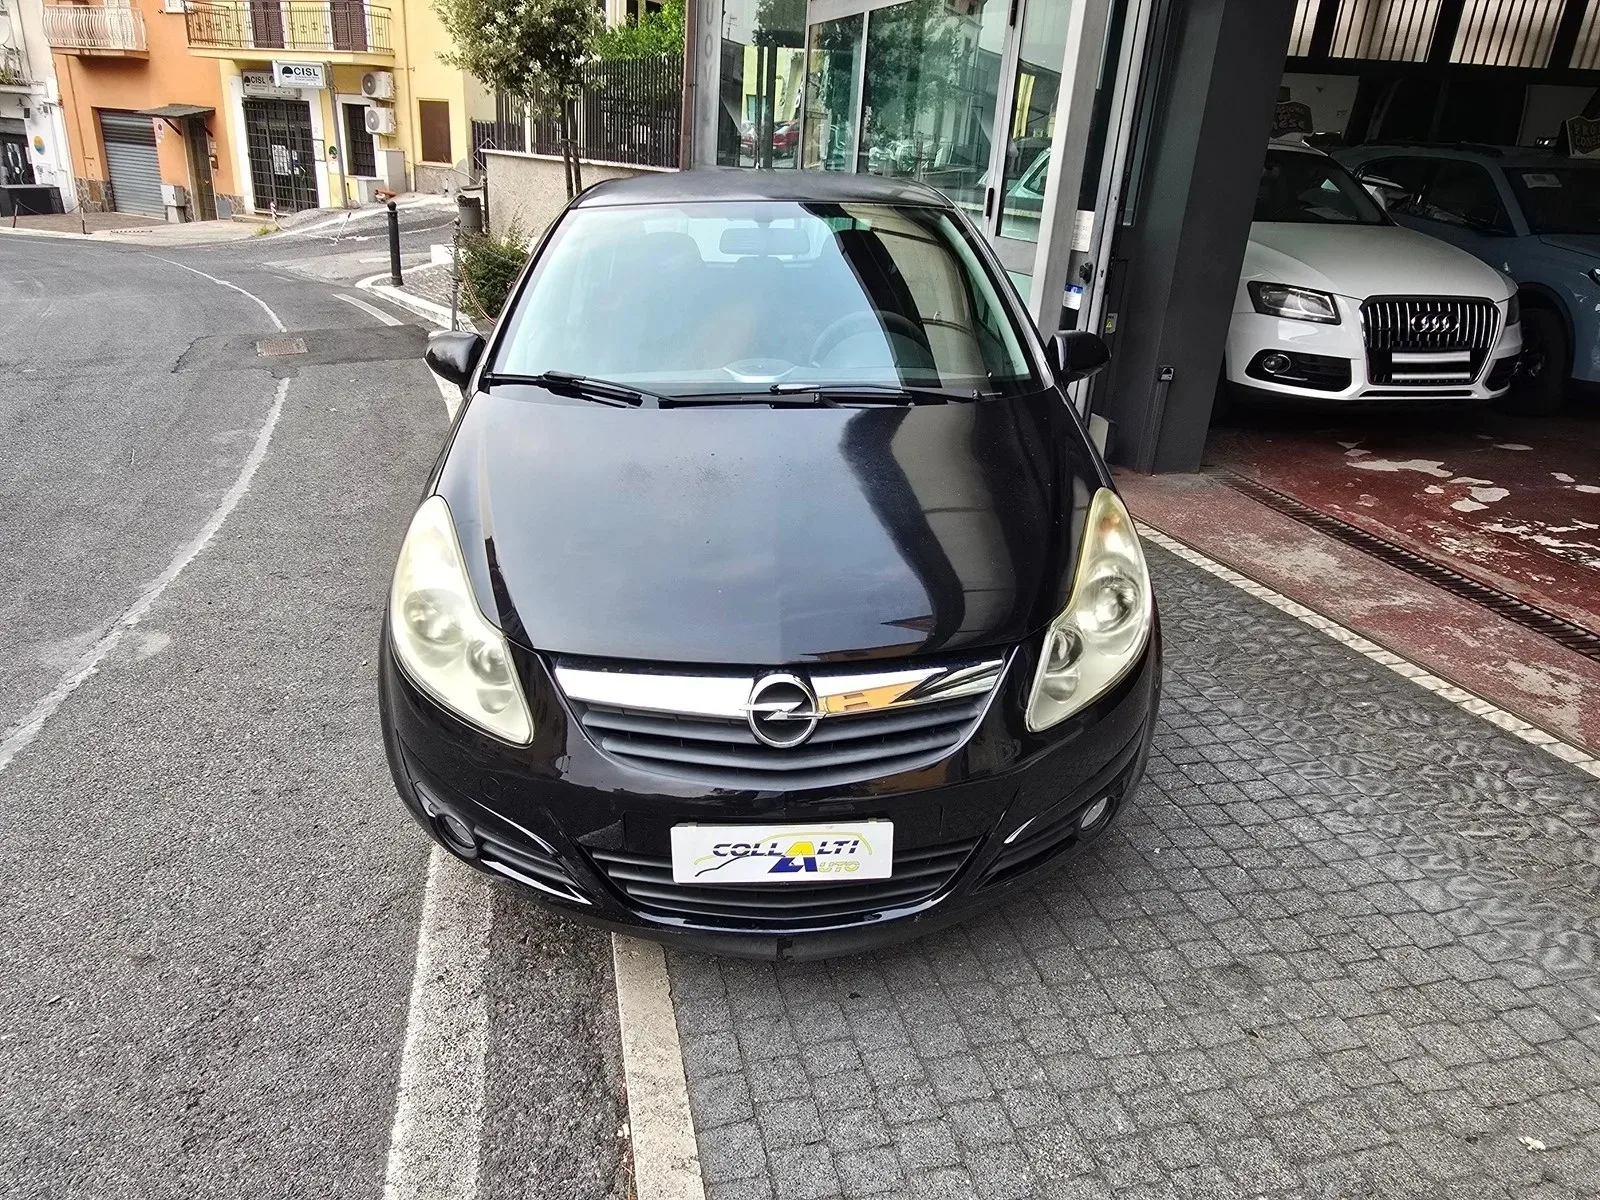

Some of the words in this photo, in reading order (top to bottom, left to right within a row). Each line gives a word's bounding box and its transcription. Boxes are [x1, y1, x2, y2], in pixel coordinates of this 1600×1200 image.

[293, 67, 319, 77] CISL
[250, 75, 267, 85] CISL
[712, 839, 860, 858] COLLALTI
